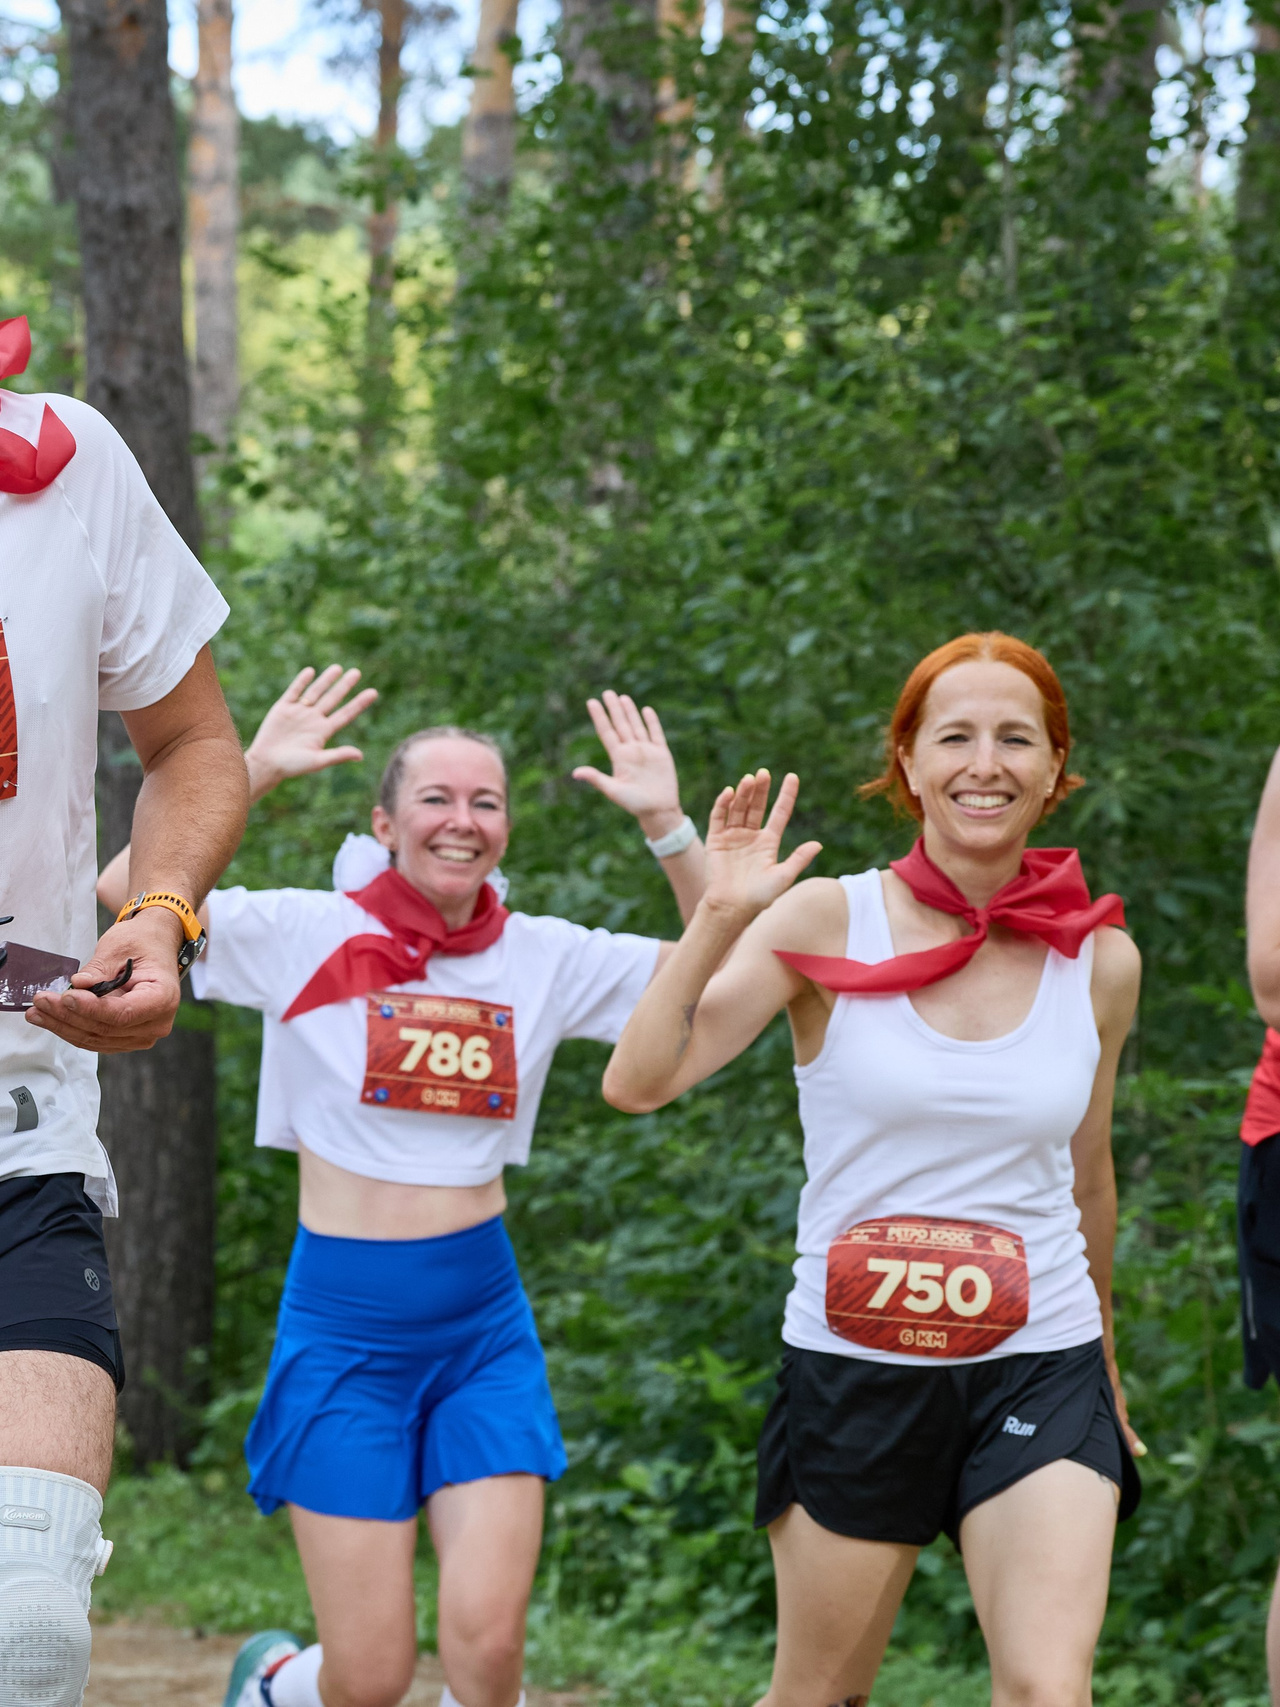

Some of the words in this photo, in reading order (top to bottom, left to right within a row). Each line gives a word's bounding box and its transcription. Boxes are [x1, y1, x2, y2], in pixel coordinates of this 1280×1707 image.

[398, 1027, 493, 1081] 786
[866, 1257, 993, 1318] 750
[899, 1328, 914, 1346] 6
[916, 1330, 948, 1349] КМ
[1002, 1415, 1037, 1437] Run
